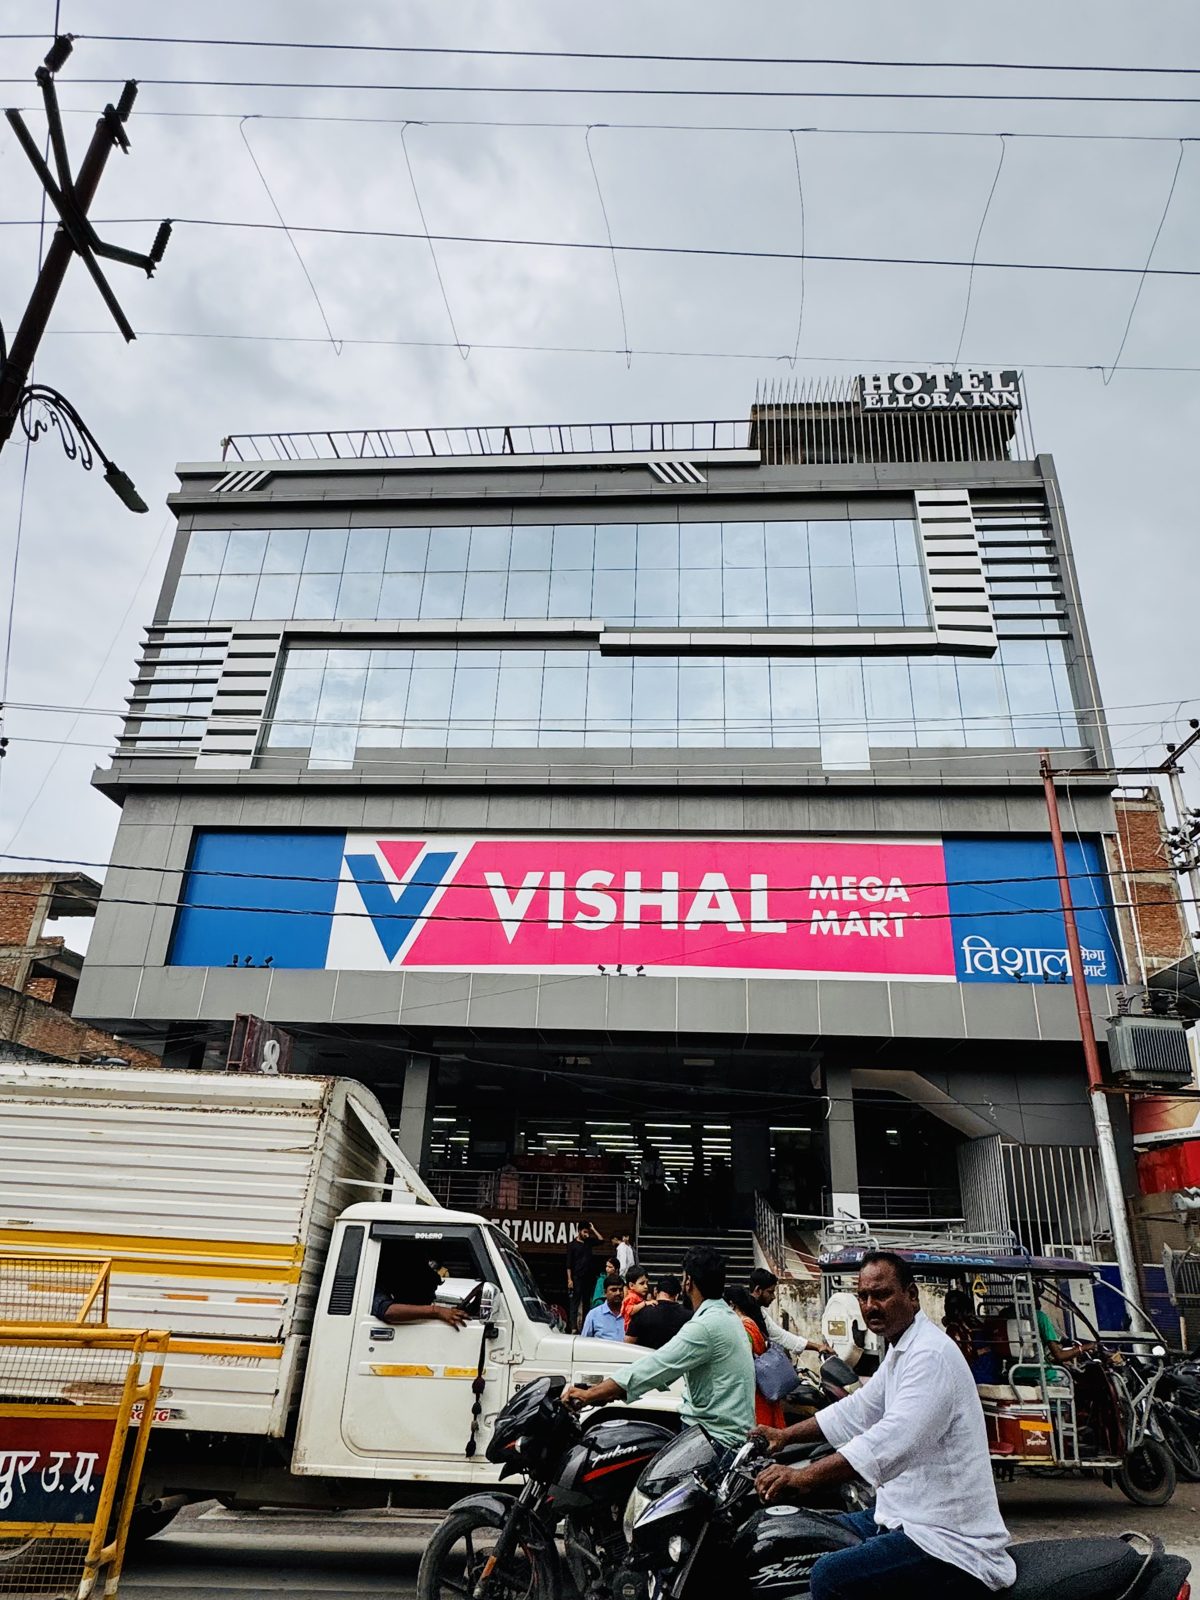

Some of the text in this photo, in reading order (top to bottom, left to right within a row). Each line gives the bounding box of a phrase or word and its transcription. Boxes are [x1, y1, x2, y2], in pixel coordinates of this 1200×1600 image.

[862, 370, 1016, 394] HOTEL
[864, 391, 1019, 409] ELLORA INN
[808, 875, 911, 902] MEGA
[484, 870, 787, 944] VISHAL
[809, 909, 908, 938] MART
[961, 935, 1073, 976] विशाल
[1079, 944, 1106, 961] मेगा
